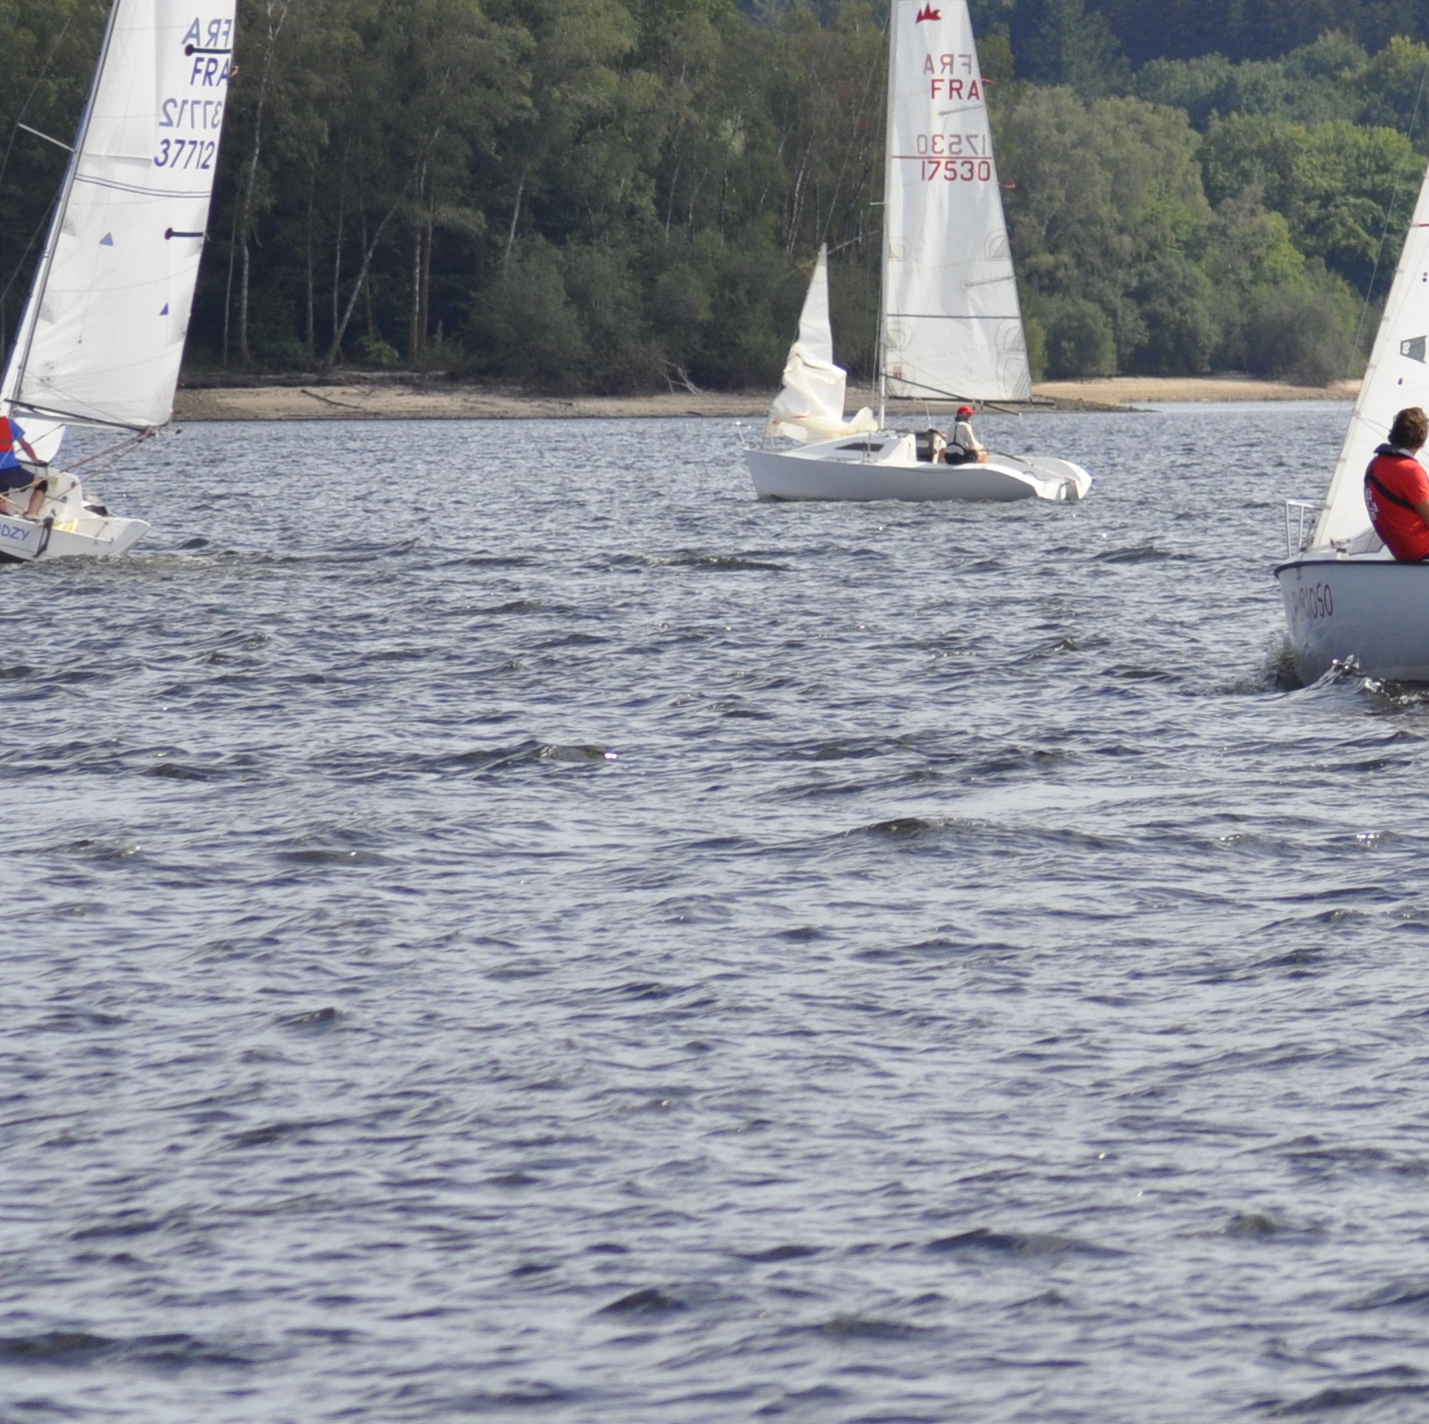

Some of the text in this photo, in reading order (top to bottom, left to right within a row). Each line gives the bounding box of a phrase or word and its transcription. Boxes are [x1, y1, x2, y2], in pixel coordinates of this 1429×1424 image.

[190, 57, 231, 87] FRA
[930, 78, 980, 100] FRA
[154, 138, 216, 170] 37712
[921, 160, 991, 182] 17530
